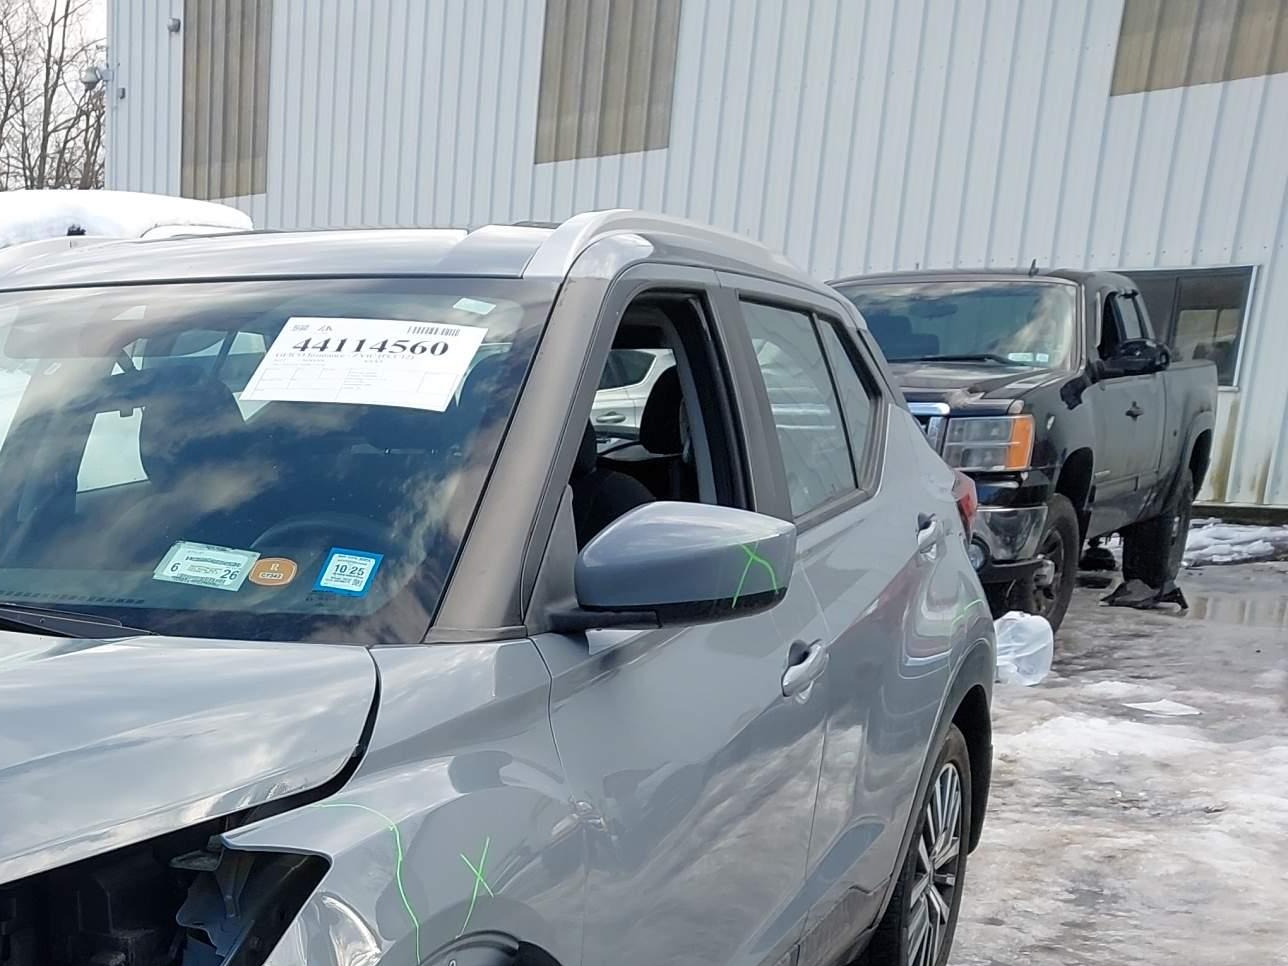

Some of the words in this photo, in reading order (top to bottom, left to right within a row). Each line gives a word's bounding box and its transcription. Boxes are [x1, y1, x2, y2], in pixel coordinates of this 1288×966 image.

[292, 336, 450, 357] 44114560
[170, 562, 181, 572] 6
[220, 569, 239, 580] 26
[335, 564, 348, 574] 10
[349, 566, 365, 576] 25
